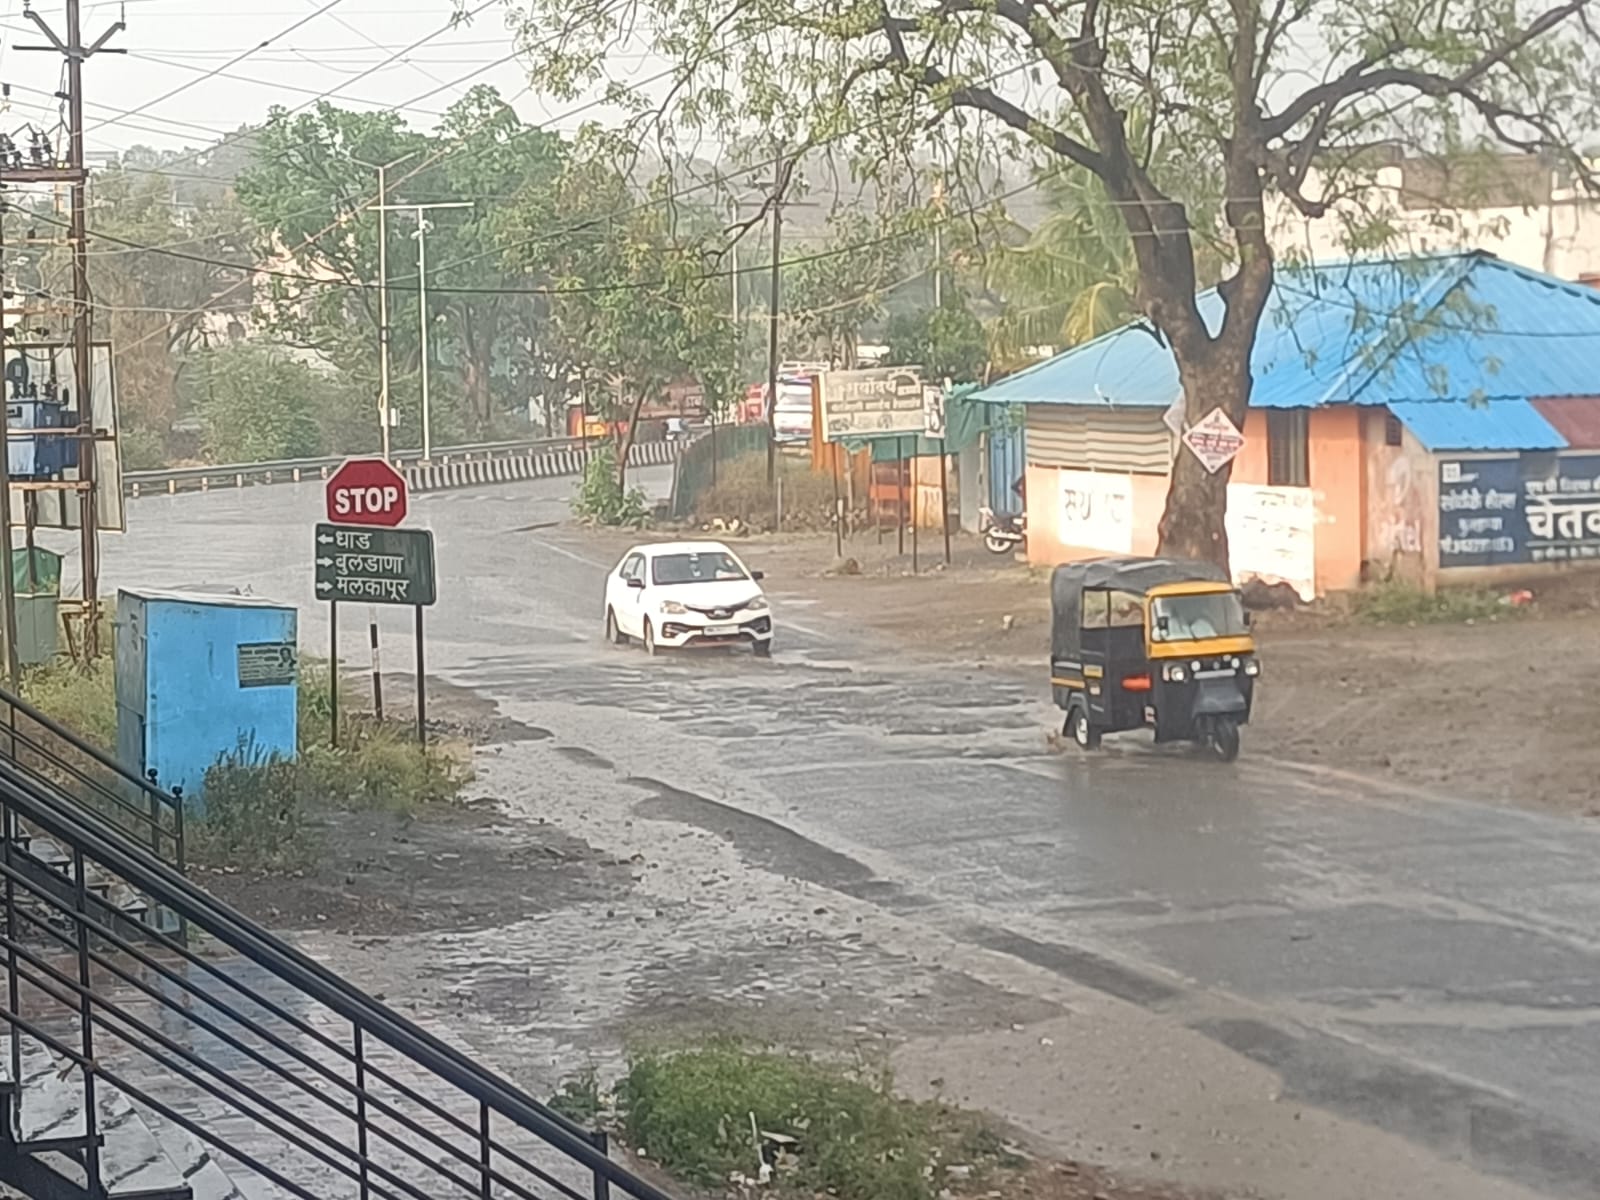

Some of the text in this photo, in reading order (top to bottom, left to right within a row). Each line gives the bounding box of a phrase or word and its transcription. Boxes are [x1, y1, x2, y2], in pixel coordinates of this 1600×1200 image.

[335, 486, 398, 514] STOP
[335, 531, 372, 549] धाड
[335, 576, 410, 600] मलकापूर
